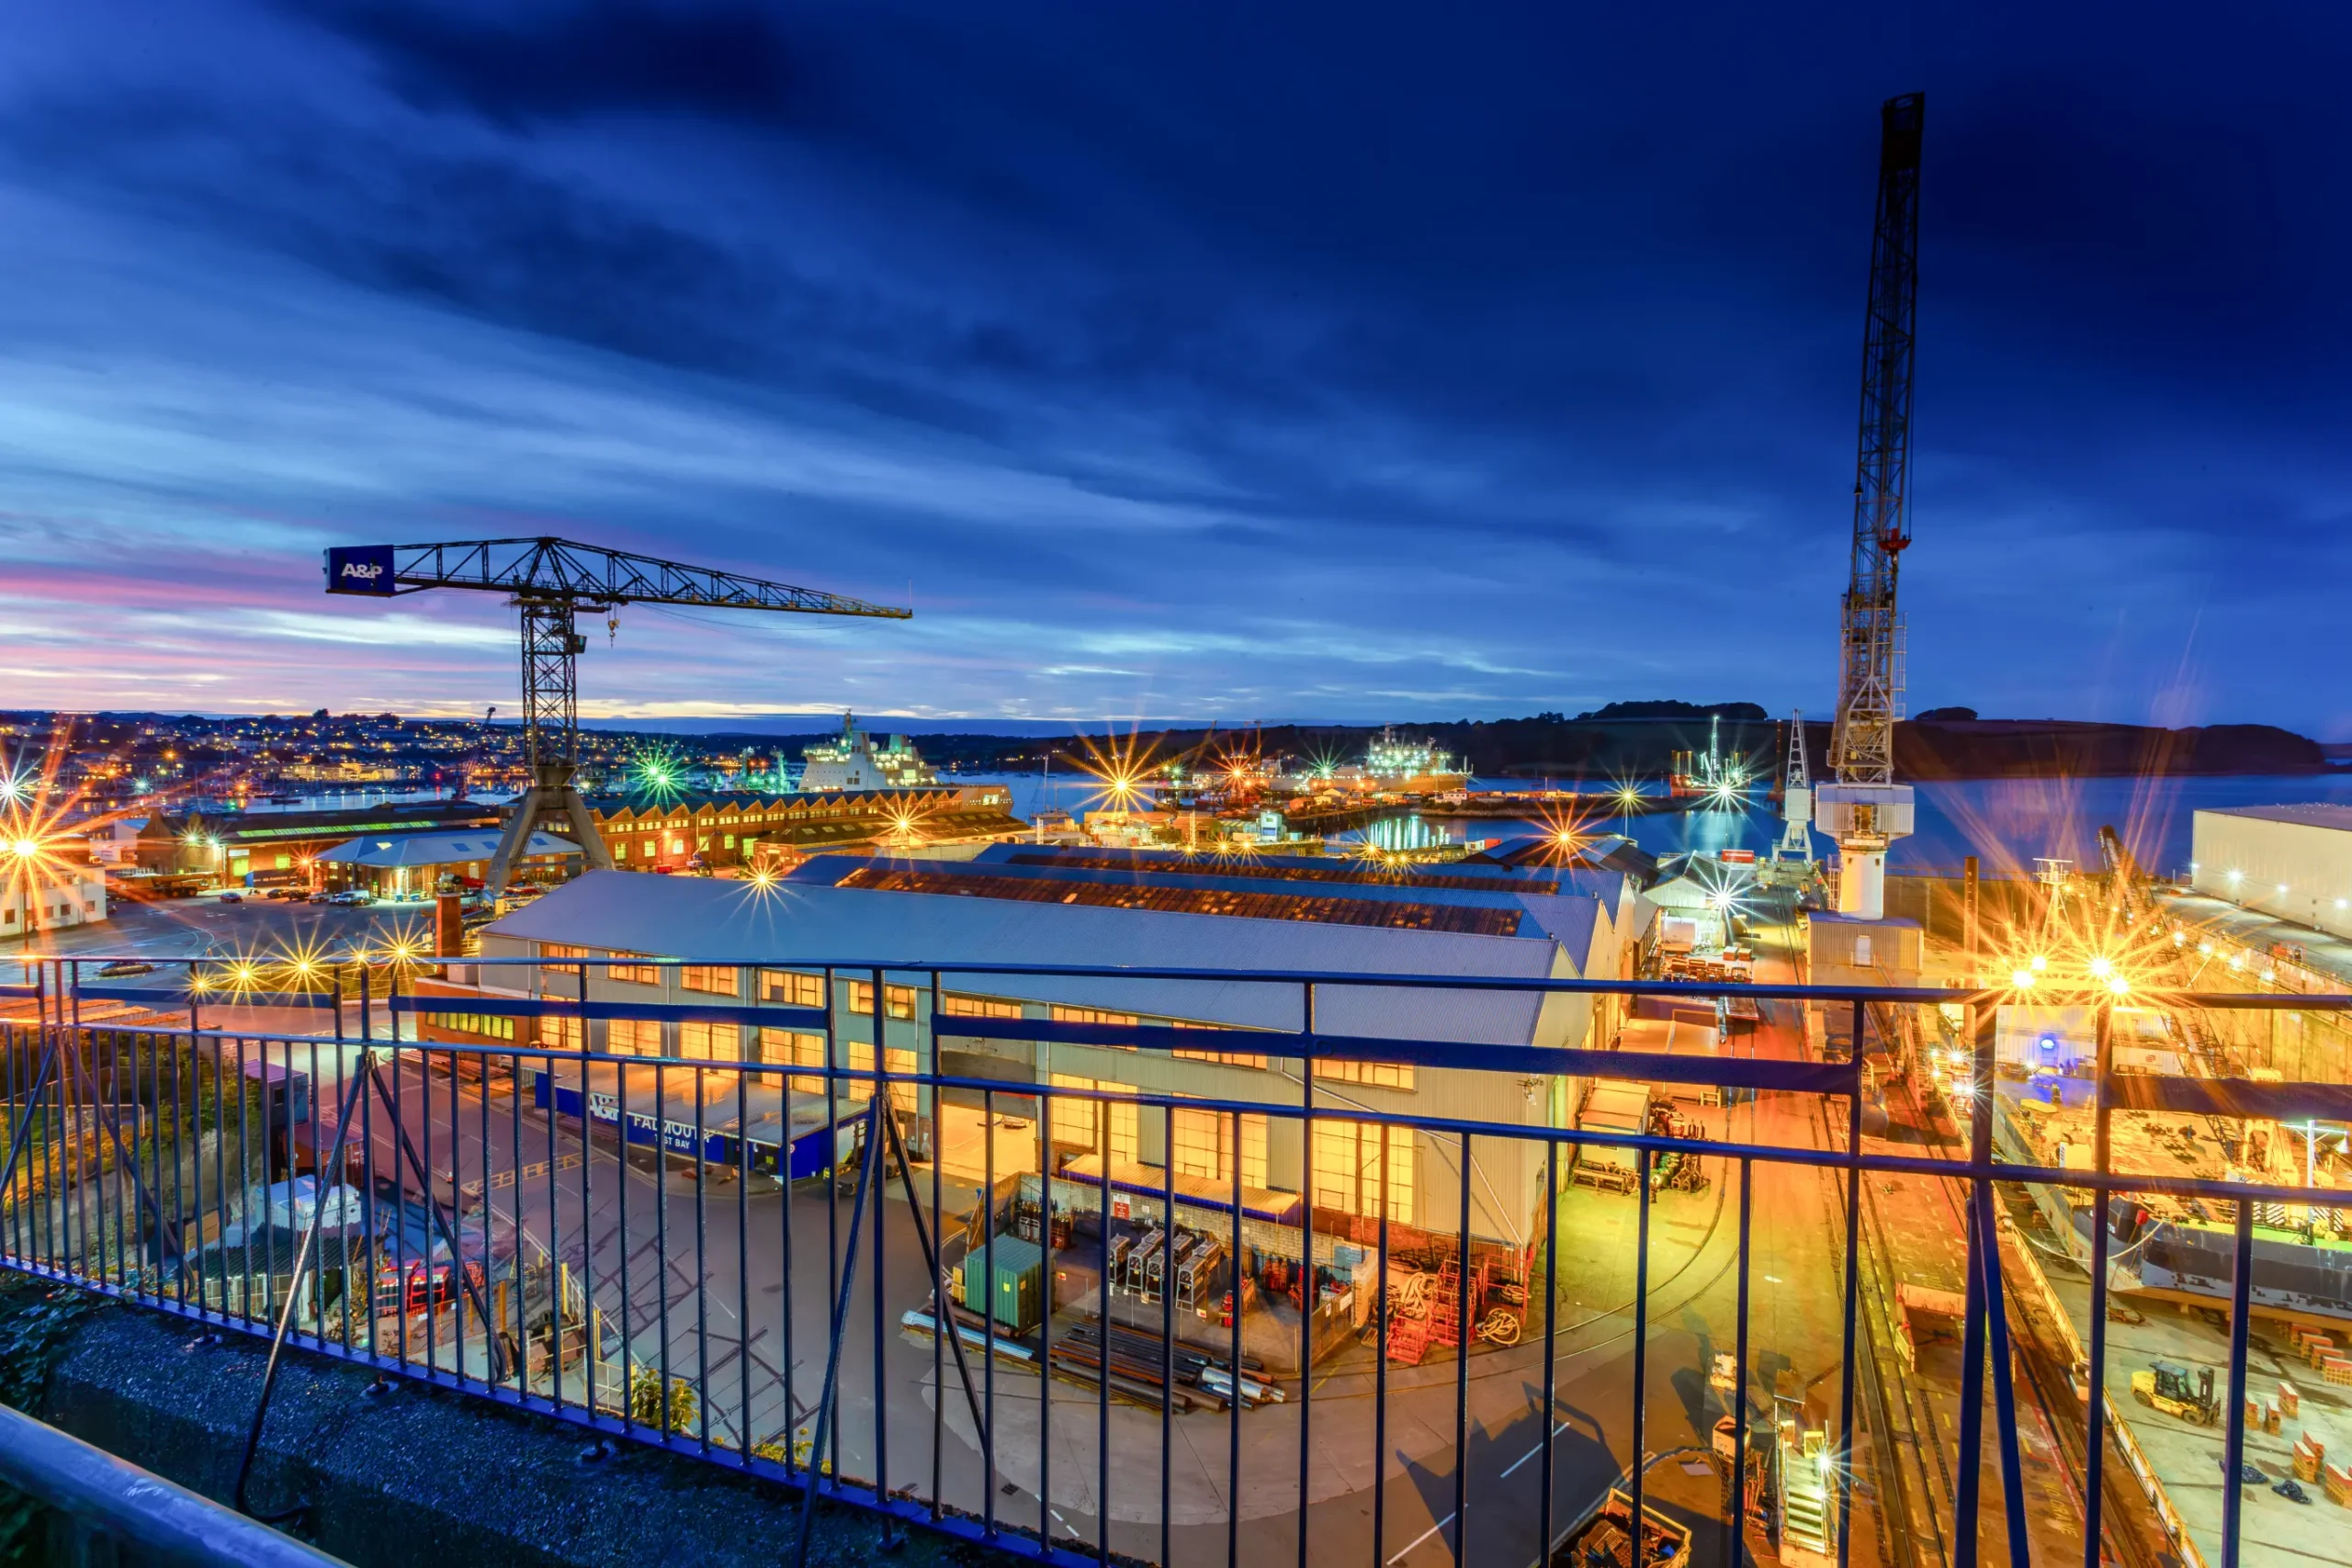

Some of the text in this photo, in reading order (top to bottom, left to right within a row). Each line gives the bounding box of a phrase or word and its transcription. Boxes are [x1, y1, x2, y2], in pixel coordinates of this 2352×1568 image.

[341, 562, 383, 579] A&P
[654, 1134, 691, 1149] TST BAY
